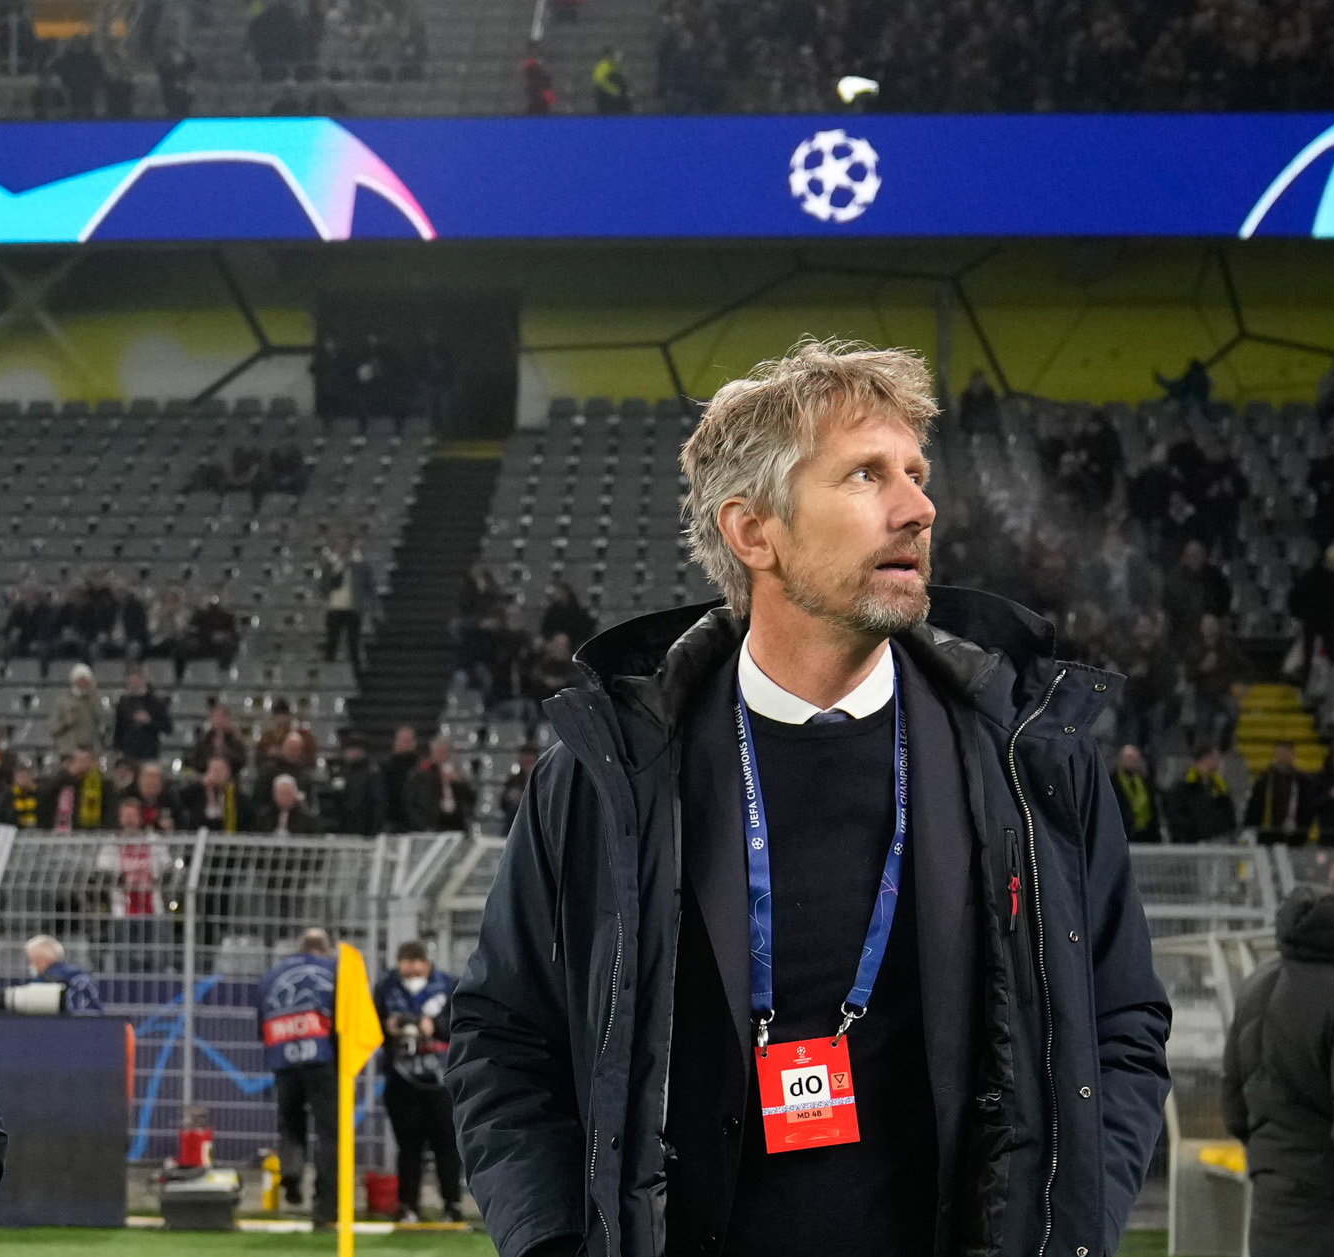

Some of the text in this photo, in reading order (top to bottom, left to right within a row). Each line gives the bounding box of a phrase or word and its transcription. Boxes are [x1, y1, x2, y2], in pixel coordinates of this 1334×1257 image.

[899, 709, 908, 746] LEAGUE
[734, 703, 760, 828] UEFA CHAMPIONS LEAGUE
[899, 747, 908, 805] CHAMPIONS
[797, 1110, 822, 1120] MD 4B
